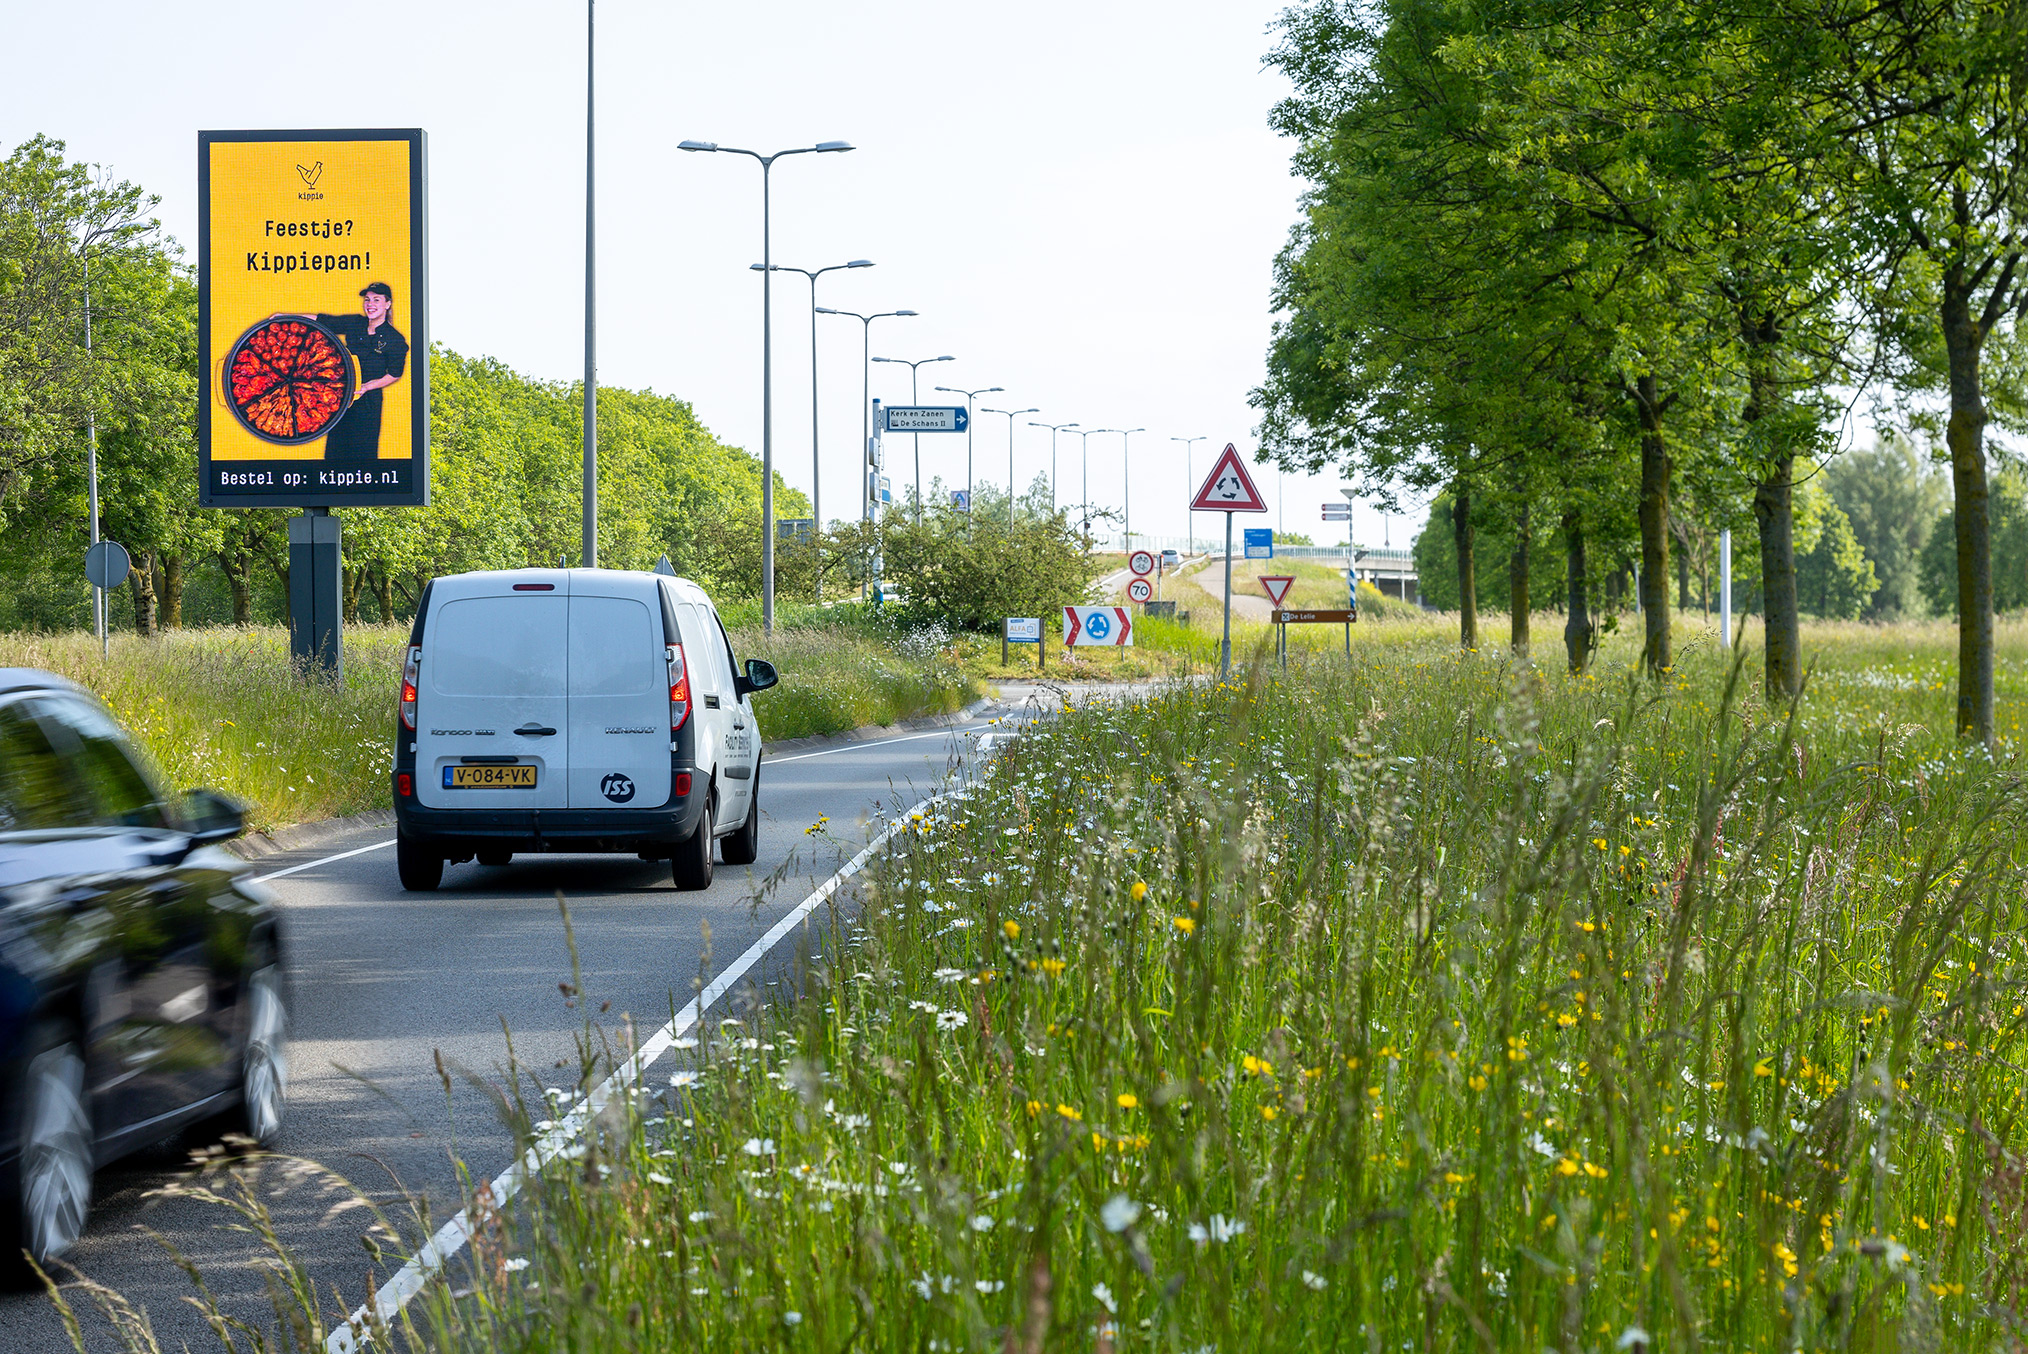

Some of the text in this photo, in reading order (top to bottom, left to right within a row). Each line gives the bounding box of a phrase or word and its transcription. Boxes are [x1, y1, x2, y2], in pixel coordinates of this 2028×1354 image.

[298, 191, 324, 201] kippie
[265, 219, 354, 239] Feestje?
[247, 251, 372, 274] Kippiepan!
[221, 470, 399, 488] Bestel op: kippie.nl
[1132, 585, 1149, 596] 70
[605, 727, 657, 735] RENAULT
[457, 768, 531, 783] V-084-VK
